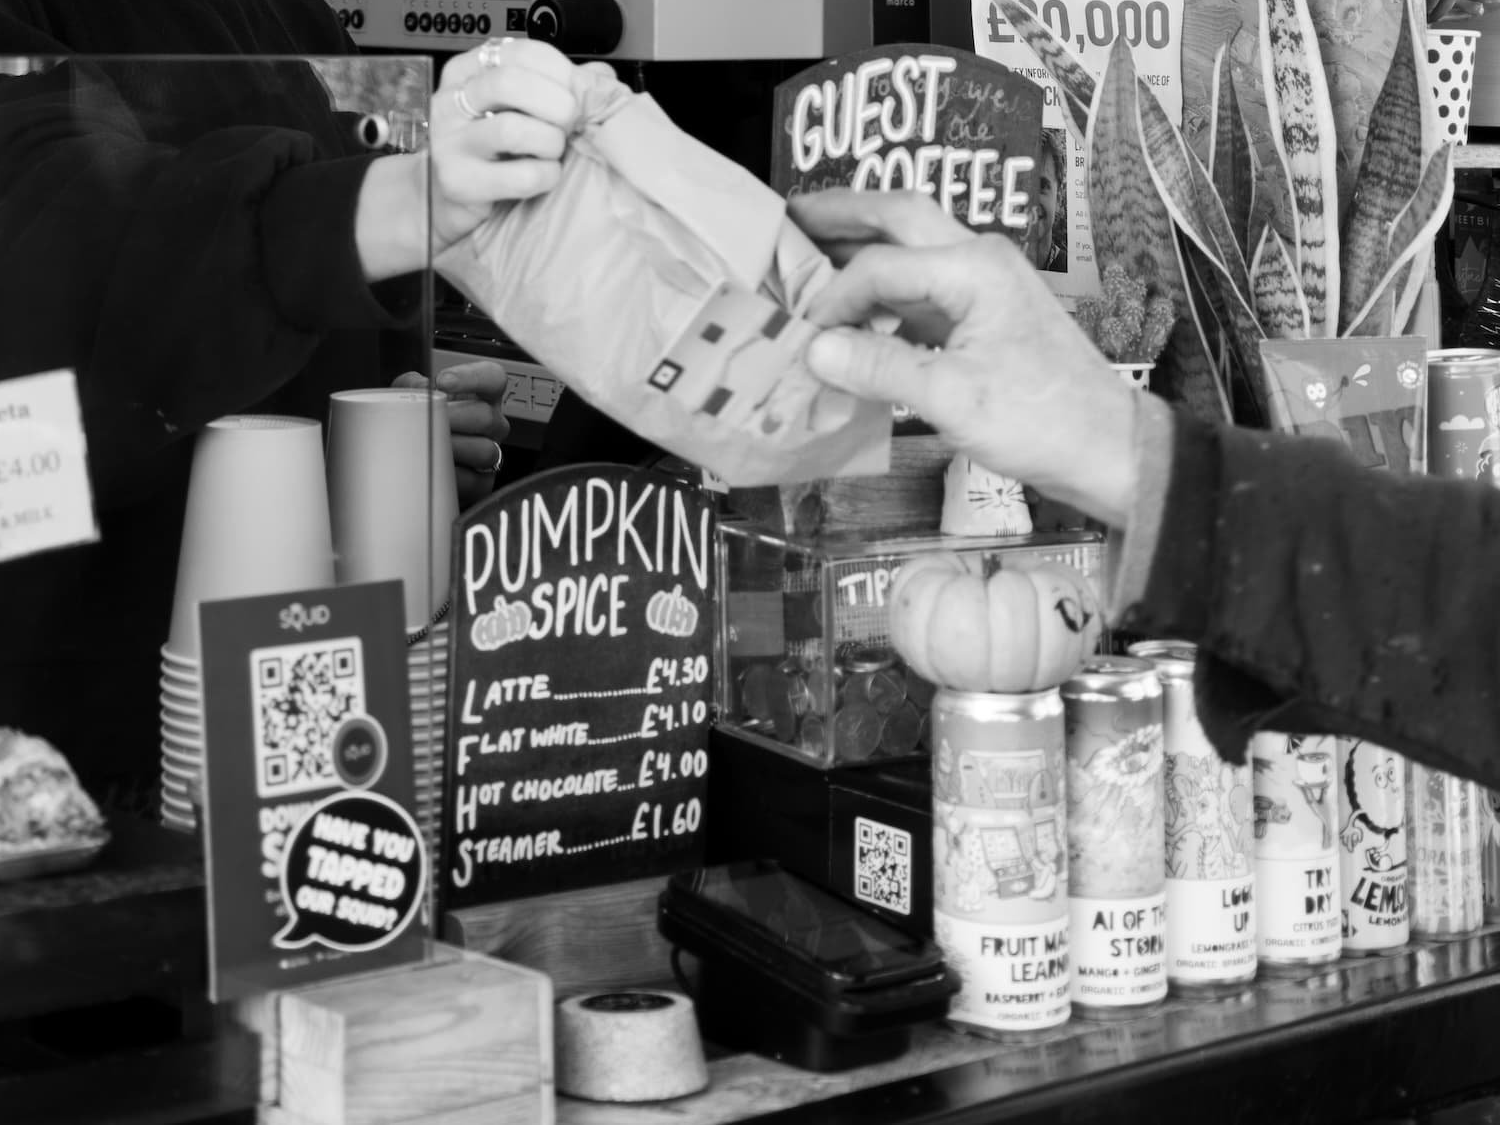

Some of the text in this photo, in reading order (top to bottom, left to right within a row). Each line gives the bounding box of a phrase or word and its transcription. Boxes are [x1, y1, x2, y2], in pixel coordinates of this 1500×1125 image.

[791, 56, 958, 173] GUEST
[463, 477, 711, 615] PUMPKIN
[278, 602, 331, 633] SQUID
[527, 573, 629, 640] SPICE
[461, 655, 709, 725] LATTE £4.30
[457, 700, 707, 776] FLAT WHITE £4.10
[456, 749, 708, 834] HOT CHOCOLATE £4.00
[312, 812, 416, 864] HAVE YOU
[453, 797, 701, 888] STEAMER £1.60
[306, 843, 407, 901] TAPPED
[1303, 866, 1333, 890] TRY
[295, 885, 337, 916] OUR
[1091, 909, 1115, 932] AI
[1122, 908, 1147, 931] OF
[1303, 892, 1334, 916] DRY
[979, 934, 1040, 958] FRUIT
[1292, 920, 1326, 934] CITRUS
[1077, 964, 1120, 979] MANGO
